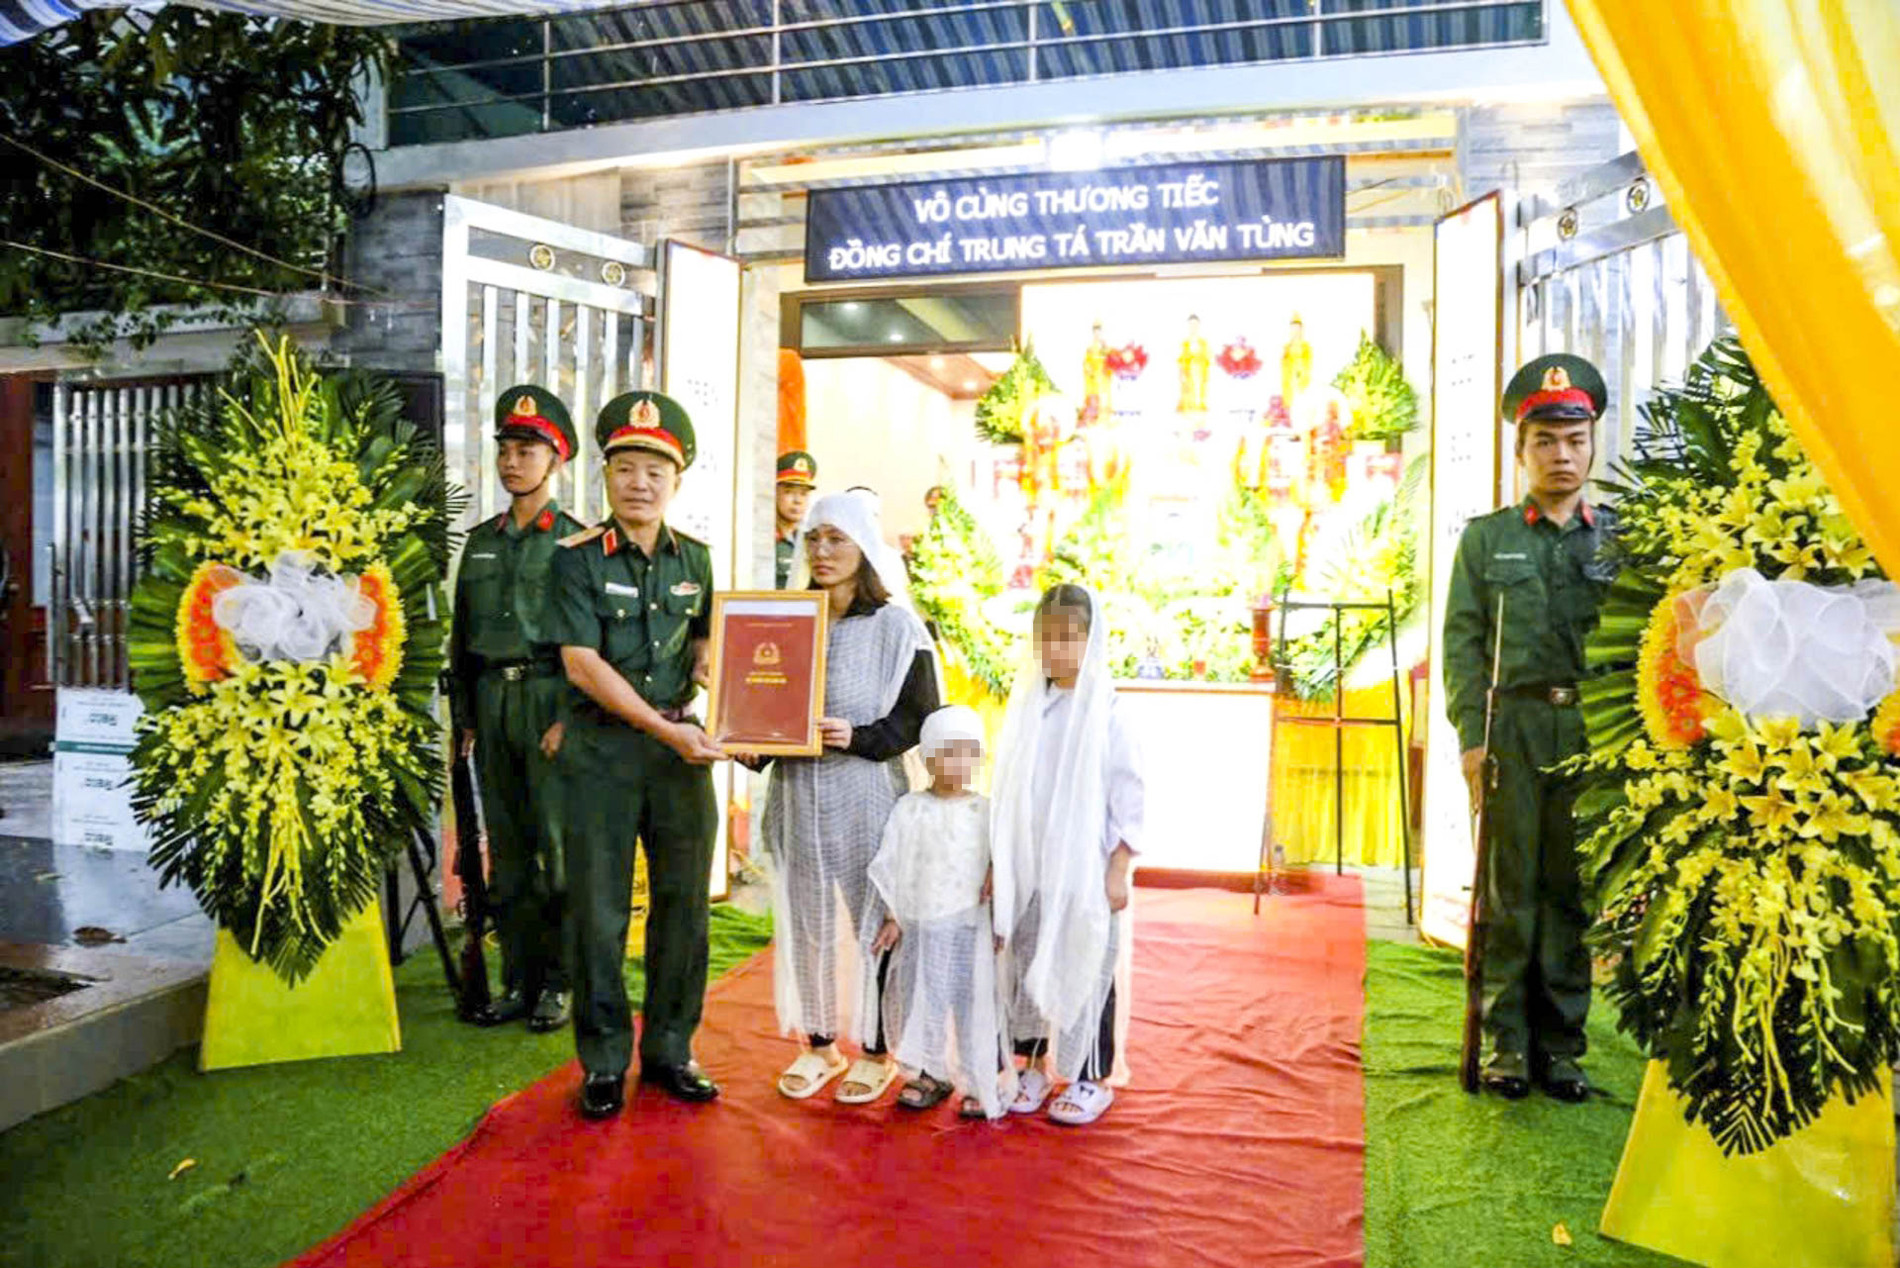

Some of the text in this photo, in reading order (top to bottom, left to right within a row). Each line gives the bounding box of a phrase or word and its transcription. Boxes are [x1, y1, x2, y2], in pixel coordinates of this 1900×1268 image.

[914, 173, 1219, 223] VÔ CÙNG THƯƠNG TIẾC
[828, 215, 1315, 270] ĐỒNG CHÍ TRUNG TÁ TRẦN VĂN TÙNG
